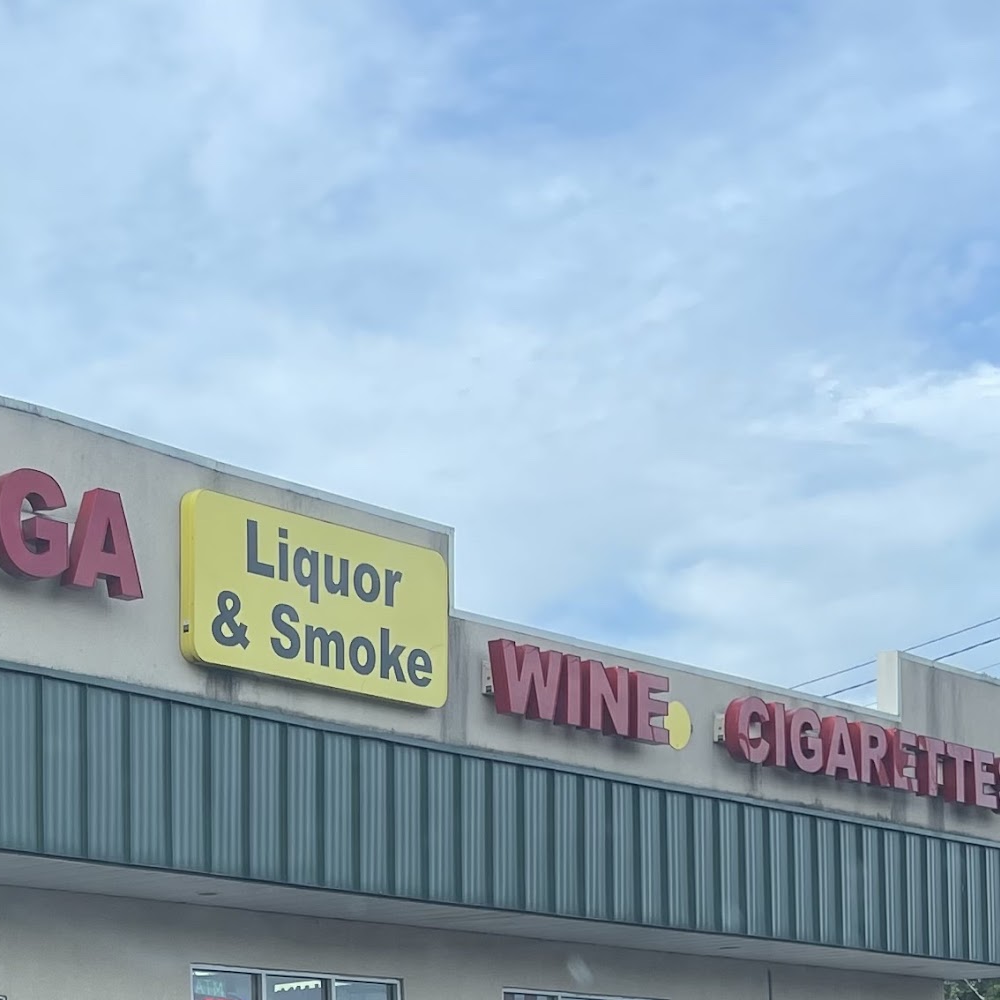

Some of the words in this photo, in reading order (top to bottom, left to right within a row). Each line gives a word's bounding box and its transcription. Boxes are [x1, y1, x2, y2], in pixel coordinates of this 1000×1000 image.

[246, 518, 403, 608] Liquor
[211, 590, 250, 650] &
[270, 603, 433, 688] Smoke
[488, 638, 670, 746] WINE
[724, 696, 1000, 814] CIGARETTE
